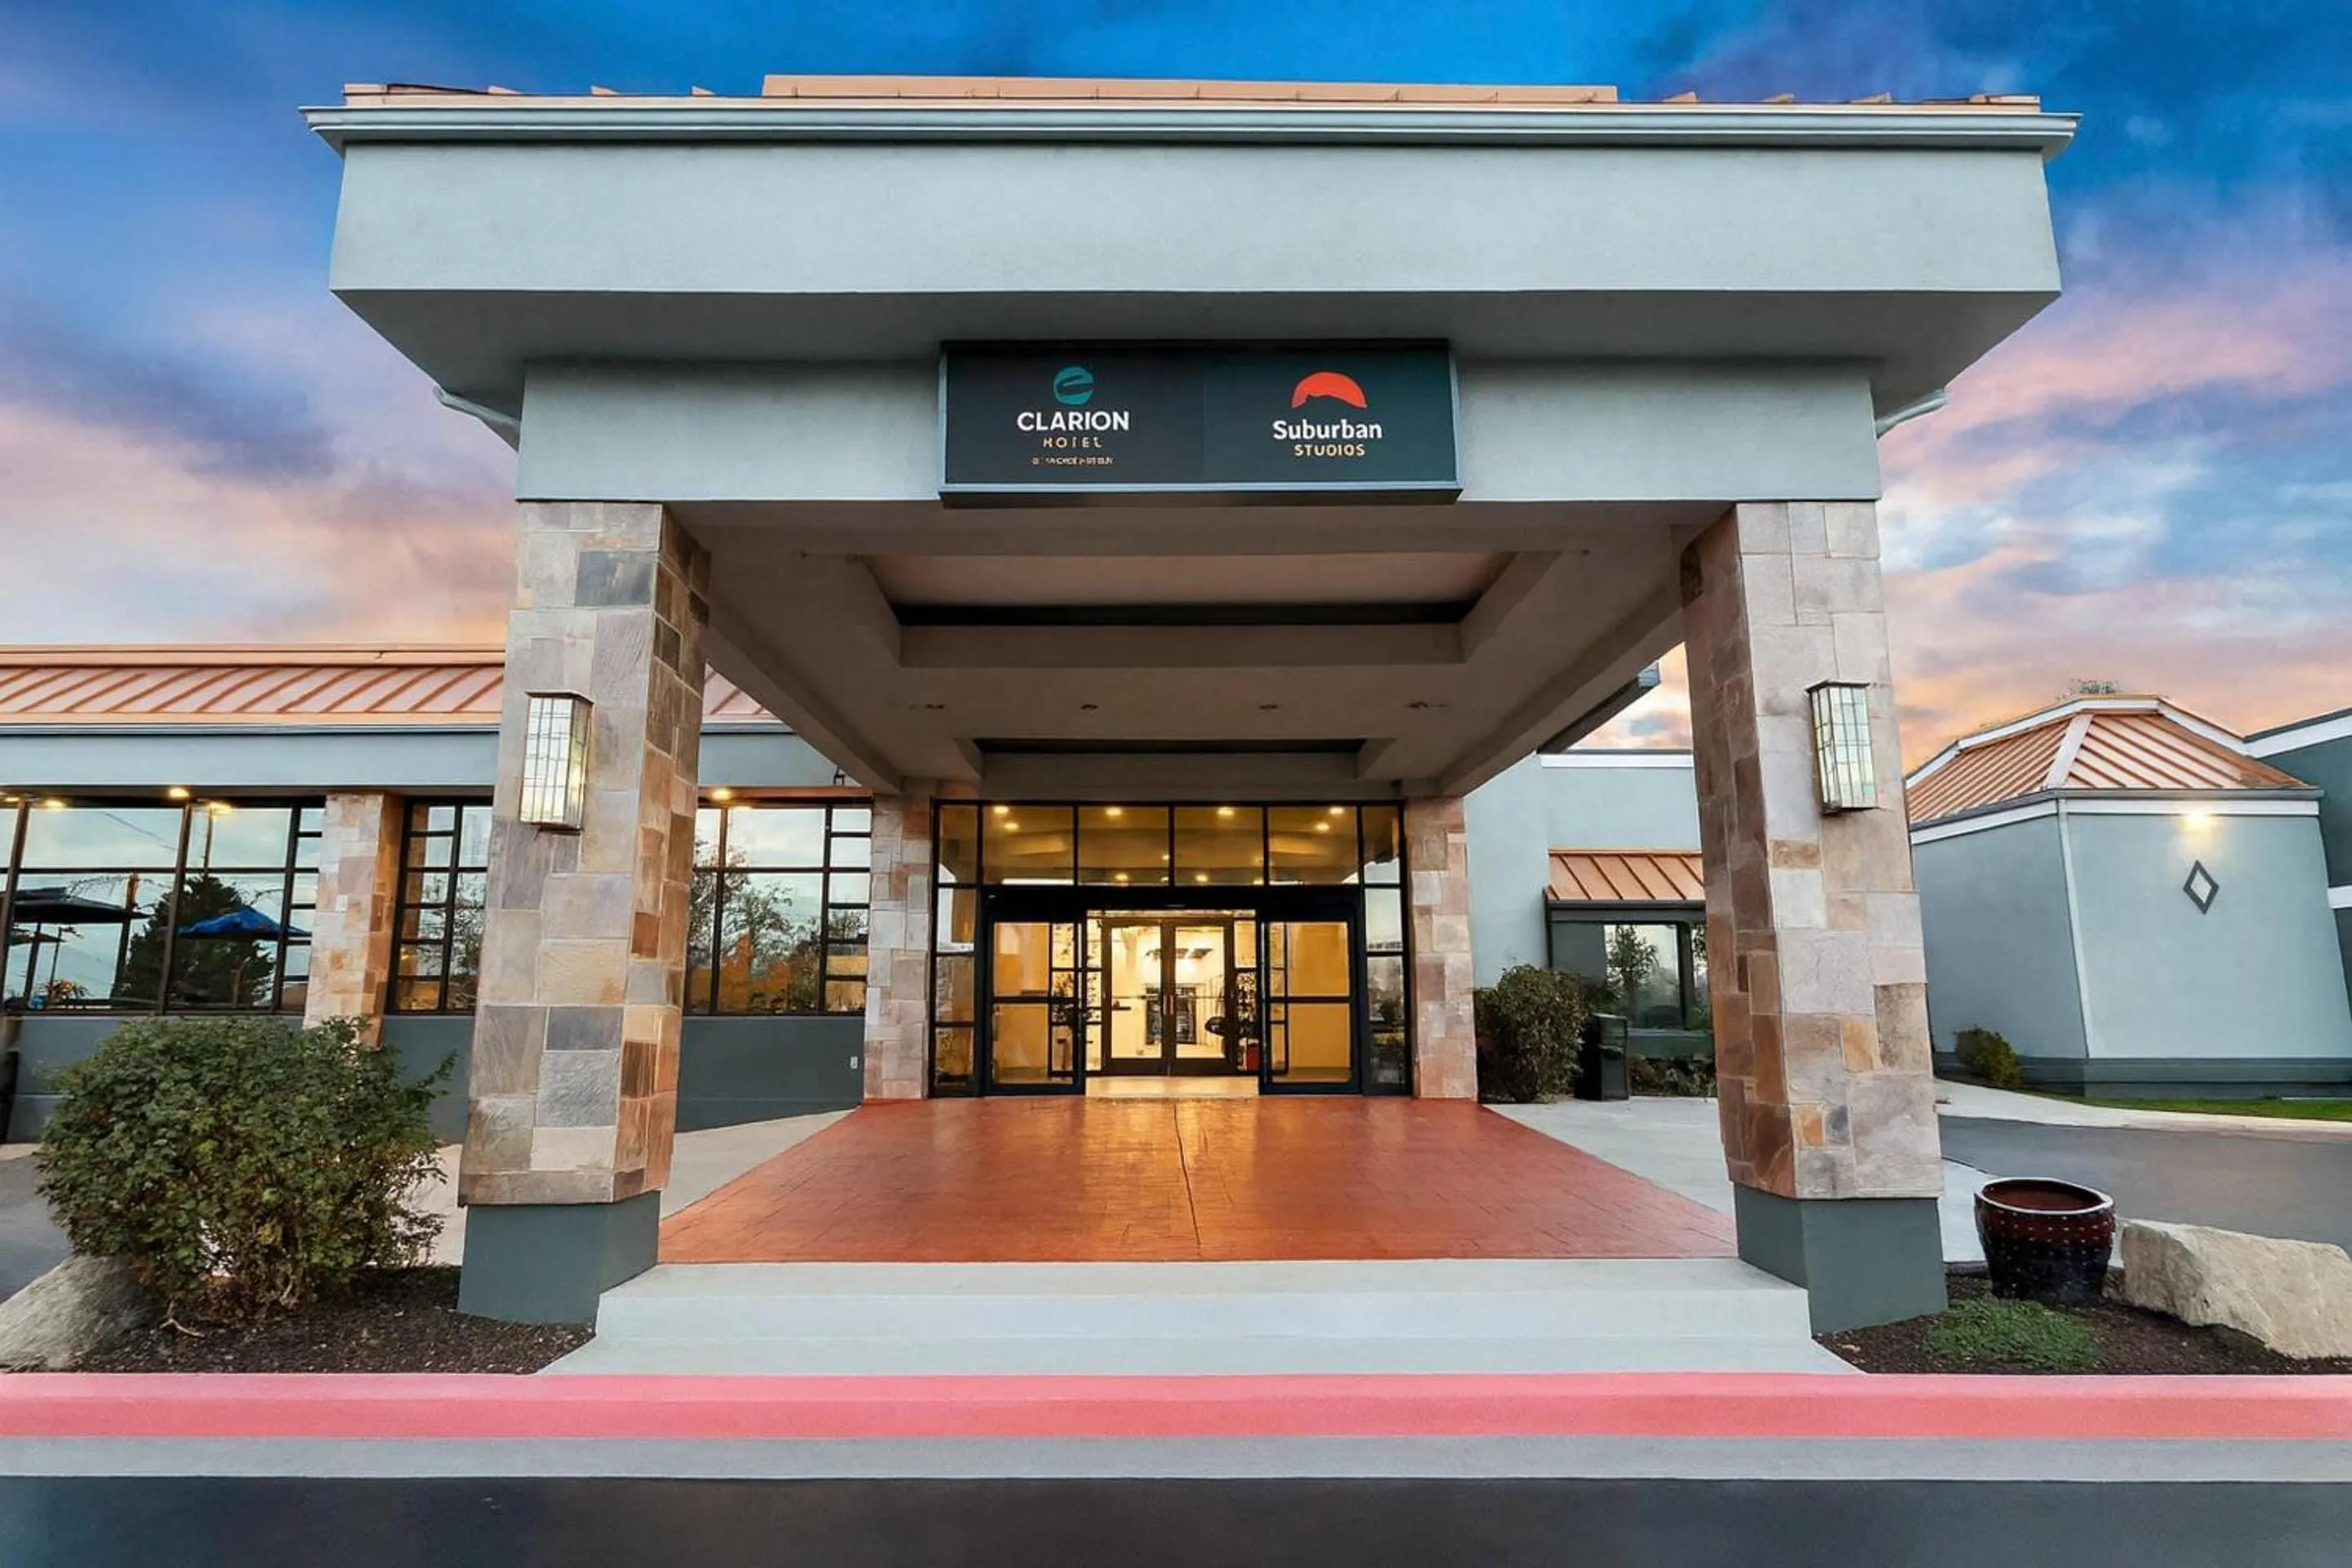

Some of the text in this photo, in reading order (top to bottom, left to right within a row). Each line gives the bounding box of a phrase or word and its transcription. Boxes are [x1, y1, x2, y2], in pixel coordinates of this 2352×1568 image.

[1017, 411, 1130, 431] CLARION
[1272, 419, 1383, 440] Suburban
[1043, 437, 1103, 448] HOTEL
[1294, 444, 1365, 457] STUDIOS
